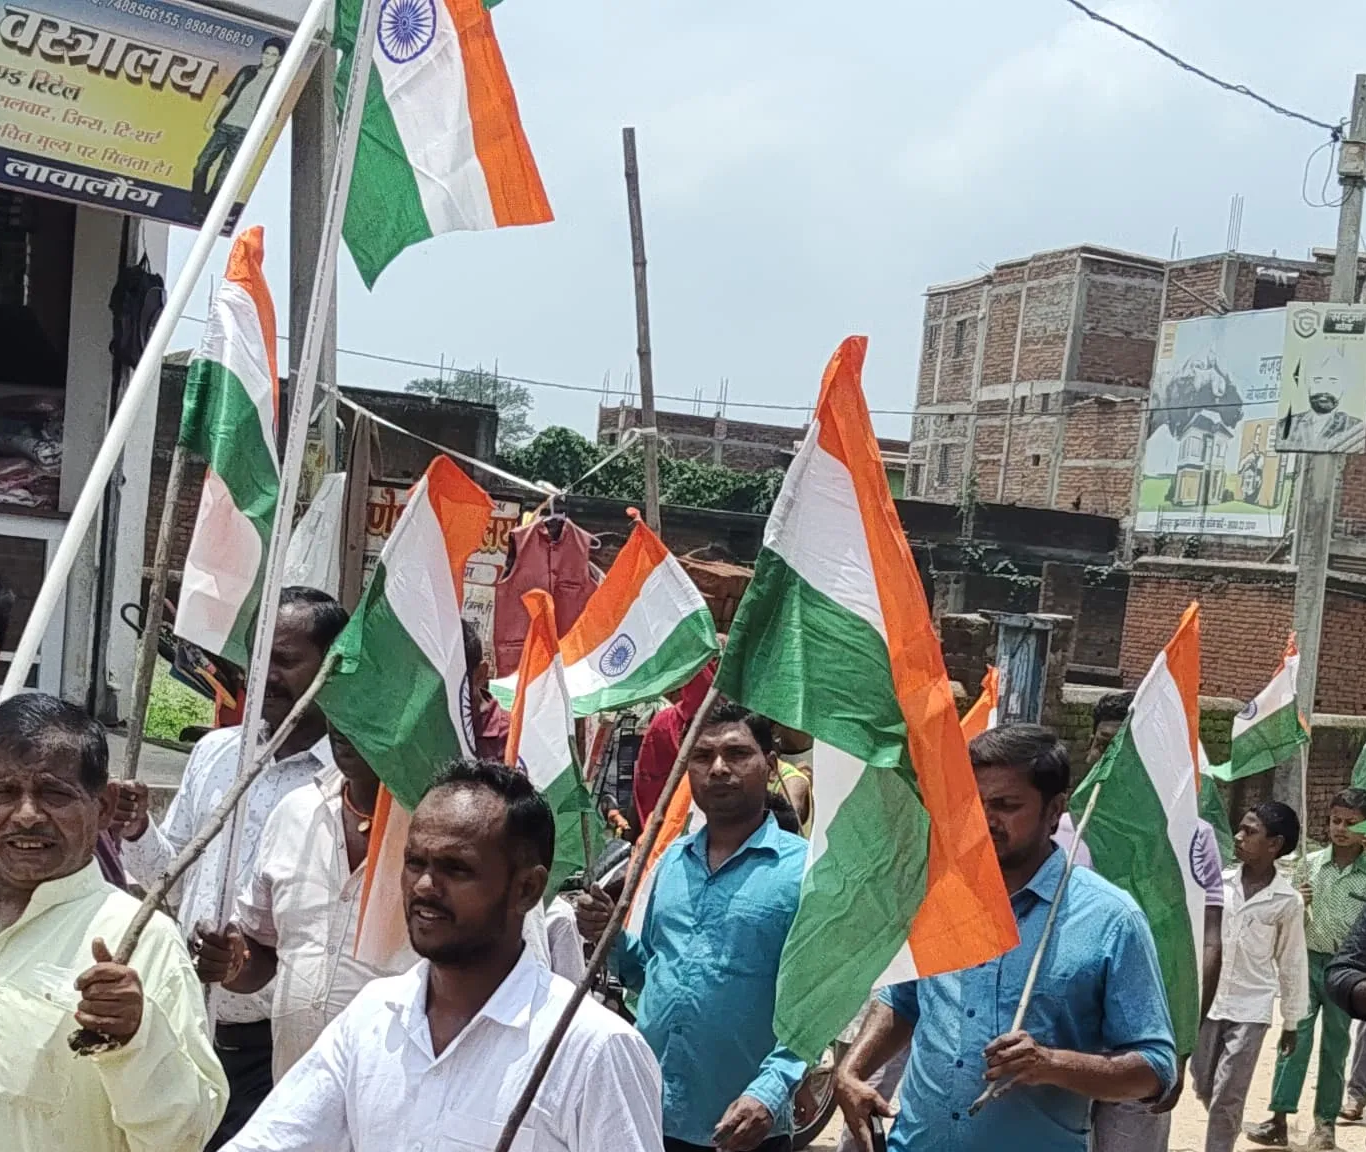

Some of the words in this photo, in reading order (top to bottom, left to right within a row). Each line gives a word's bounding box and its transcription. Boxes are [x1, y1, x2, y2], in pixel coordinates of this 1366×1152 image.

[28, 69, 84, 101] रिटेल
[77, 144, 98, 160] पर
[5, 157, 163, 208] लावालौंग
